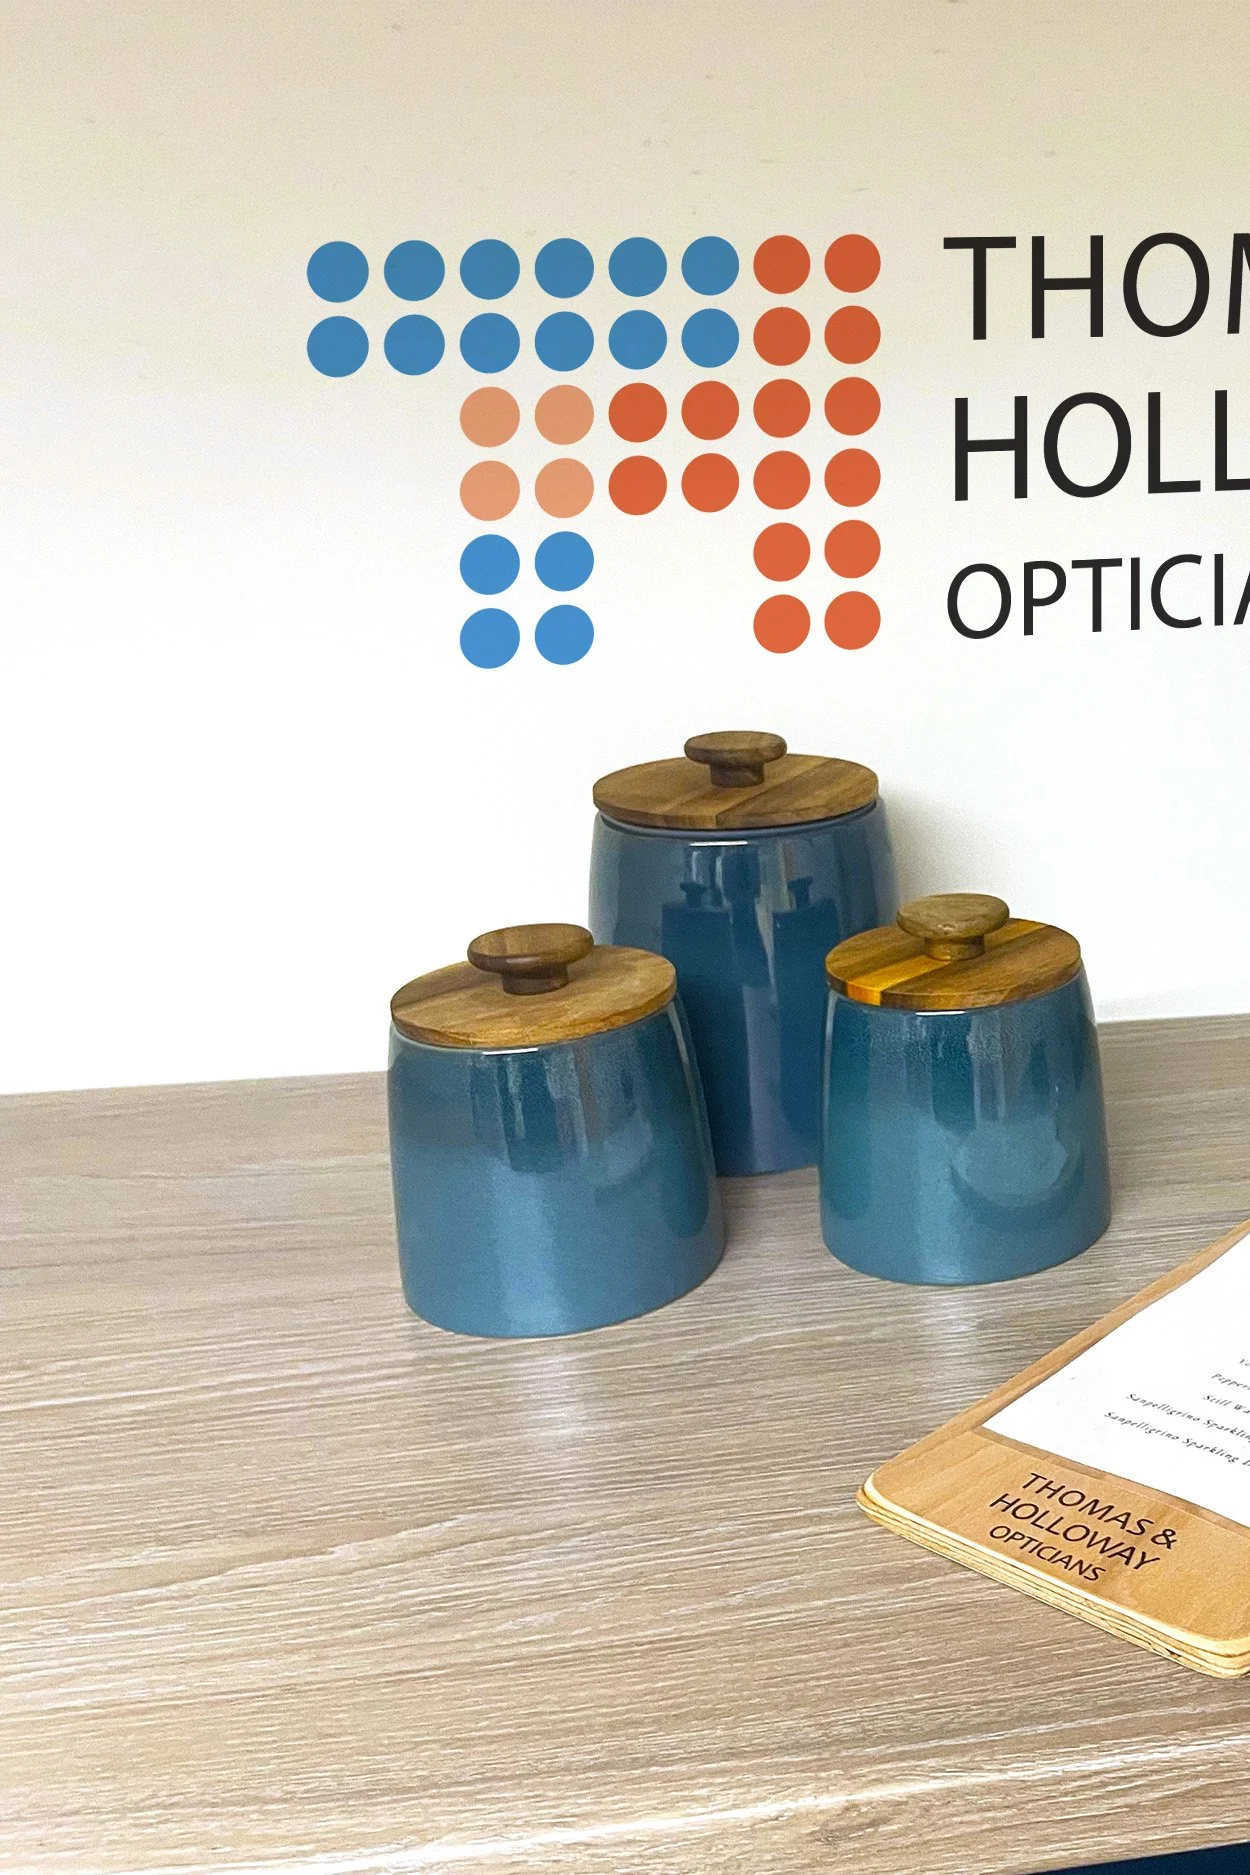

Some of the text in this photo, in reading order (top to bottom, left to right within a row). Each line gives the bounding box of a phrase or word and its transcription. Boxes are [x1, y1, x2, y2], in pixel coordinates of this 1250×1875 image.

[1202, 1394, 1233, 1407] Still
[1104, 1411, 1180, 1440] Sanpelligrino
[1182, 1438, 1239, 1463] Sparkling
[989, 1492, 1161, 1570] HOLLOWAY
[1022, 1472, 1178, 1550] THOMAS &
[989, 1525, 1106, 1581] OPTICIANS
